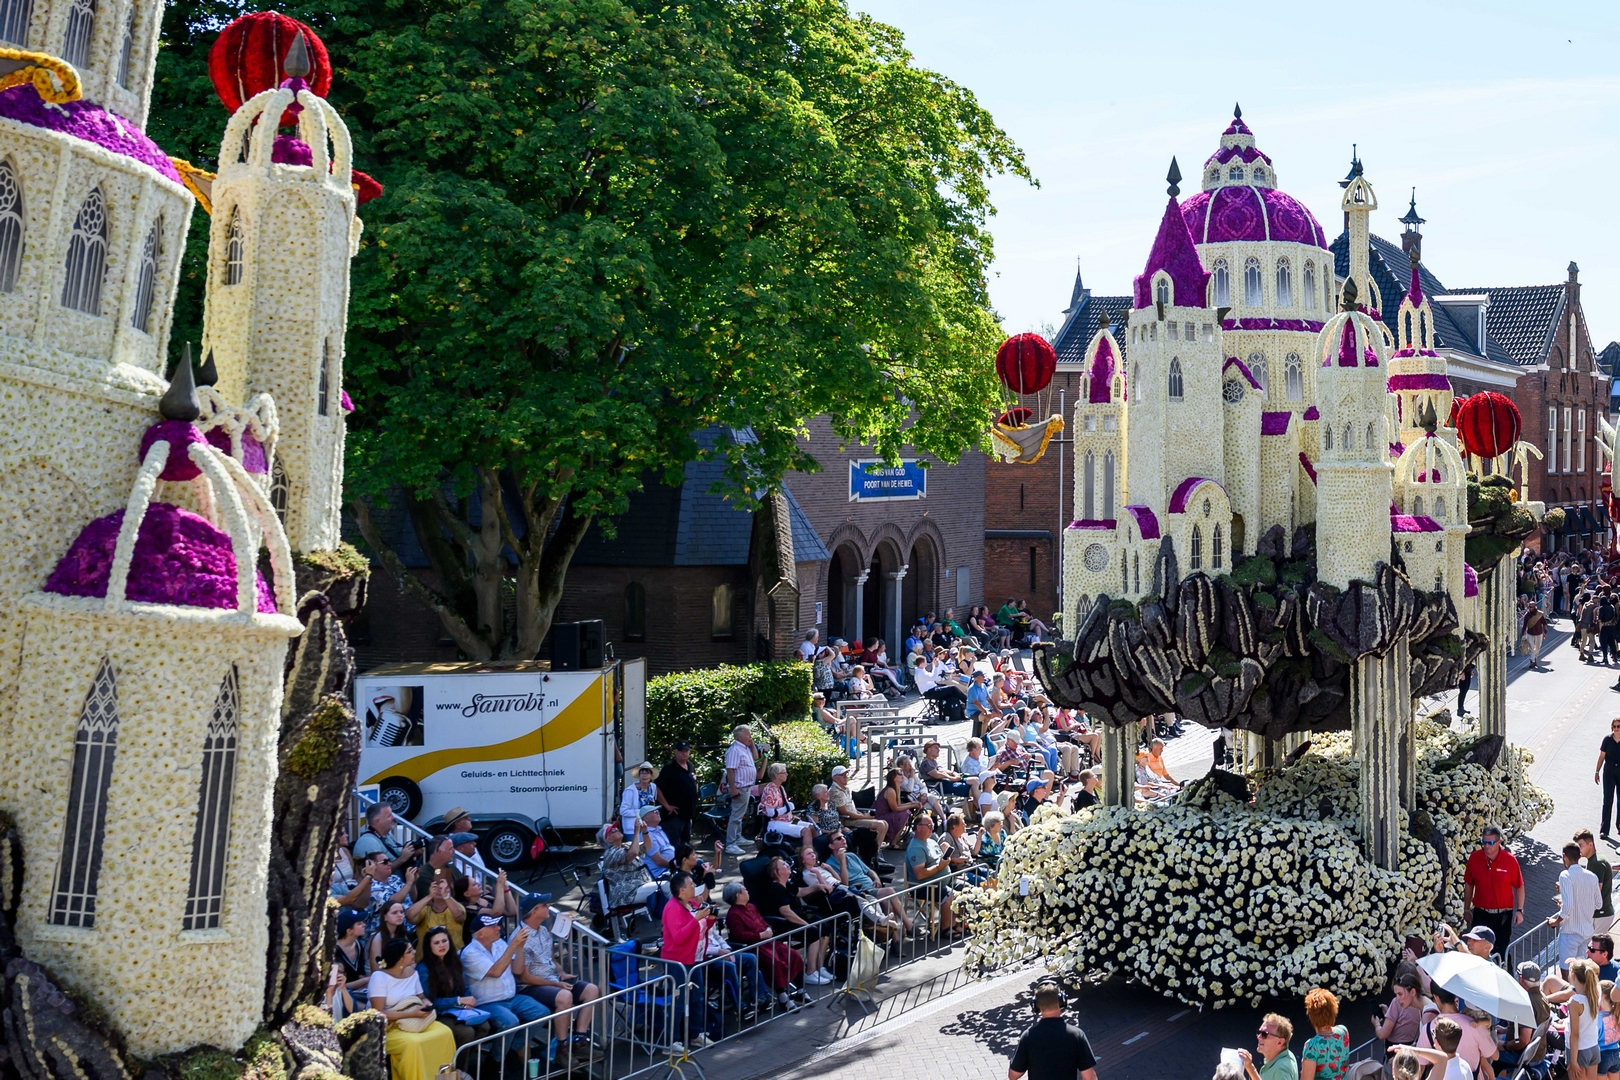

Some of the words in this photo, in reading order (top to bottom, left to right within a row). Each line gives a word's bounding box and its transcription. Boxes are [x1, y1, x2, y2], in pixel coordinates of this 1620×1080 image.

[895, 468, 906, 476] GOD
[864, 480, 880, 489] POORT
[881, 480, 890, 488] VAN
[891, 480, 897, 488] DE
[898, 479, 913, 488] HEMEL
[460, 770, 496, 778] Geluids-
[510, 769, 566, 777] Lichttechniek
[510, 784, 588, 793] Stroomvoorziening
